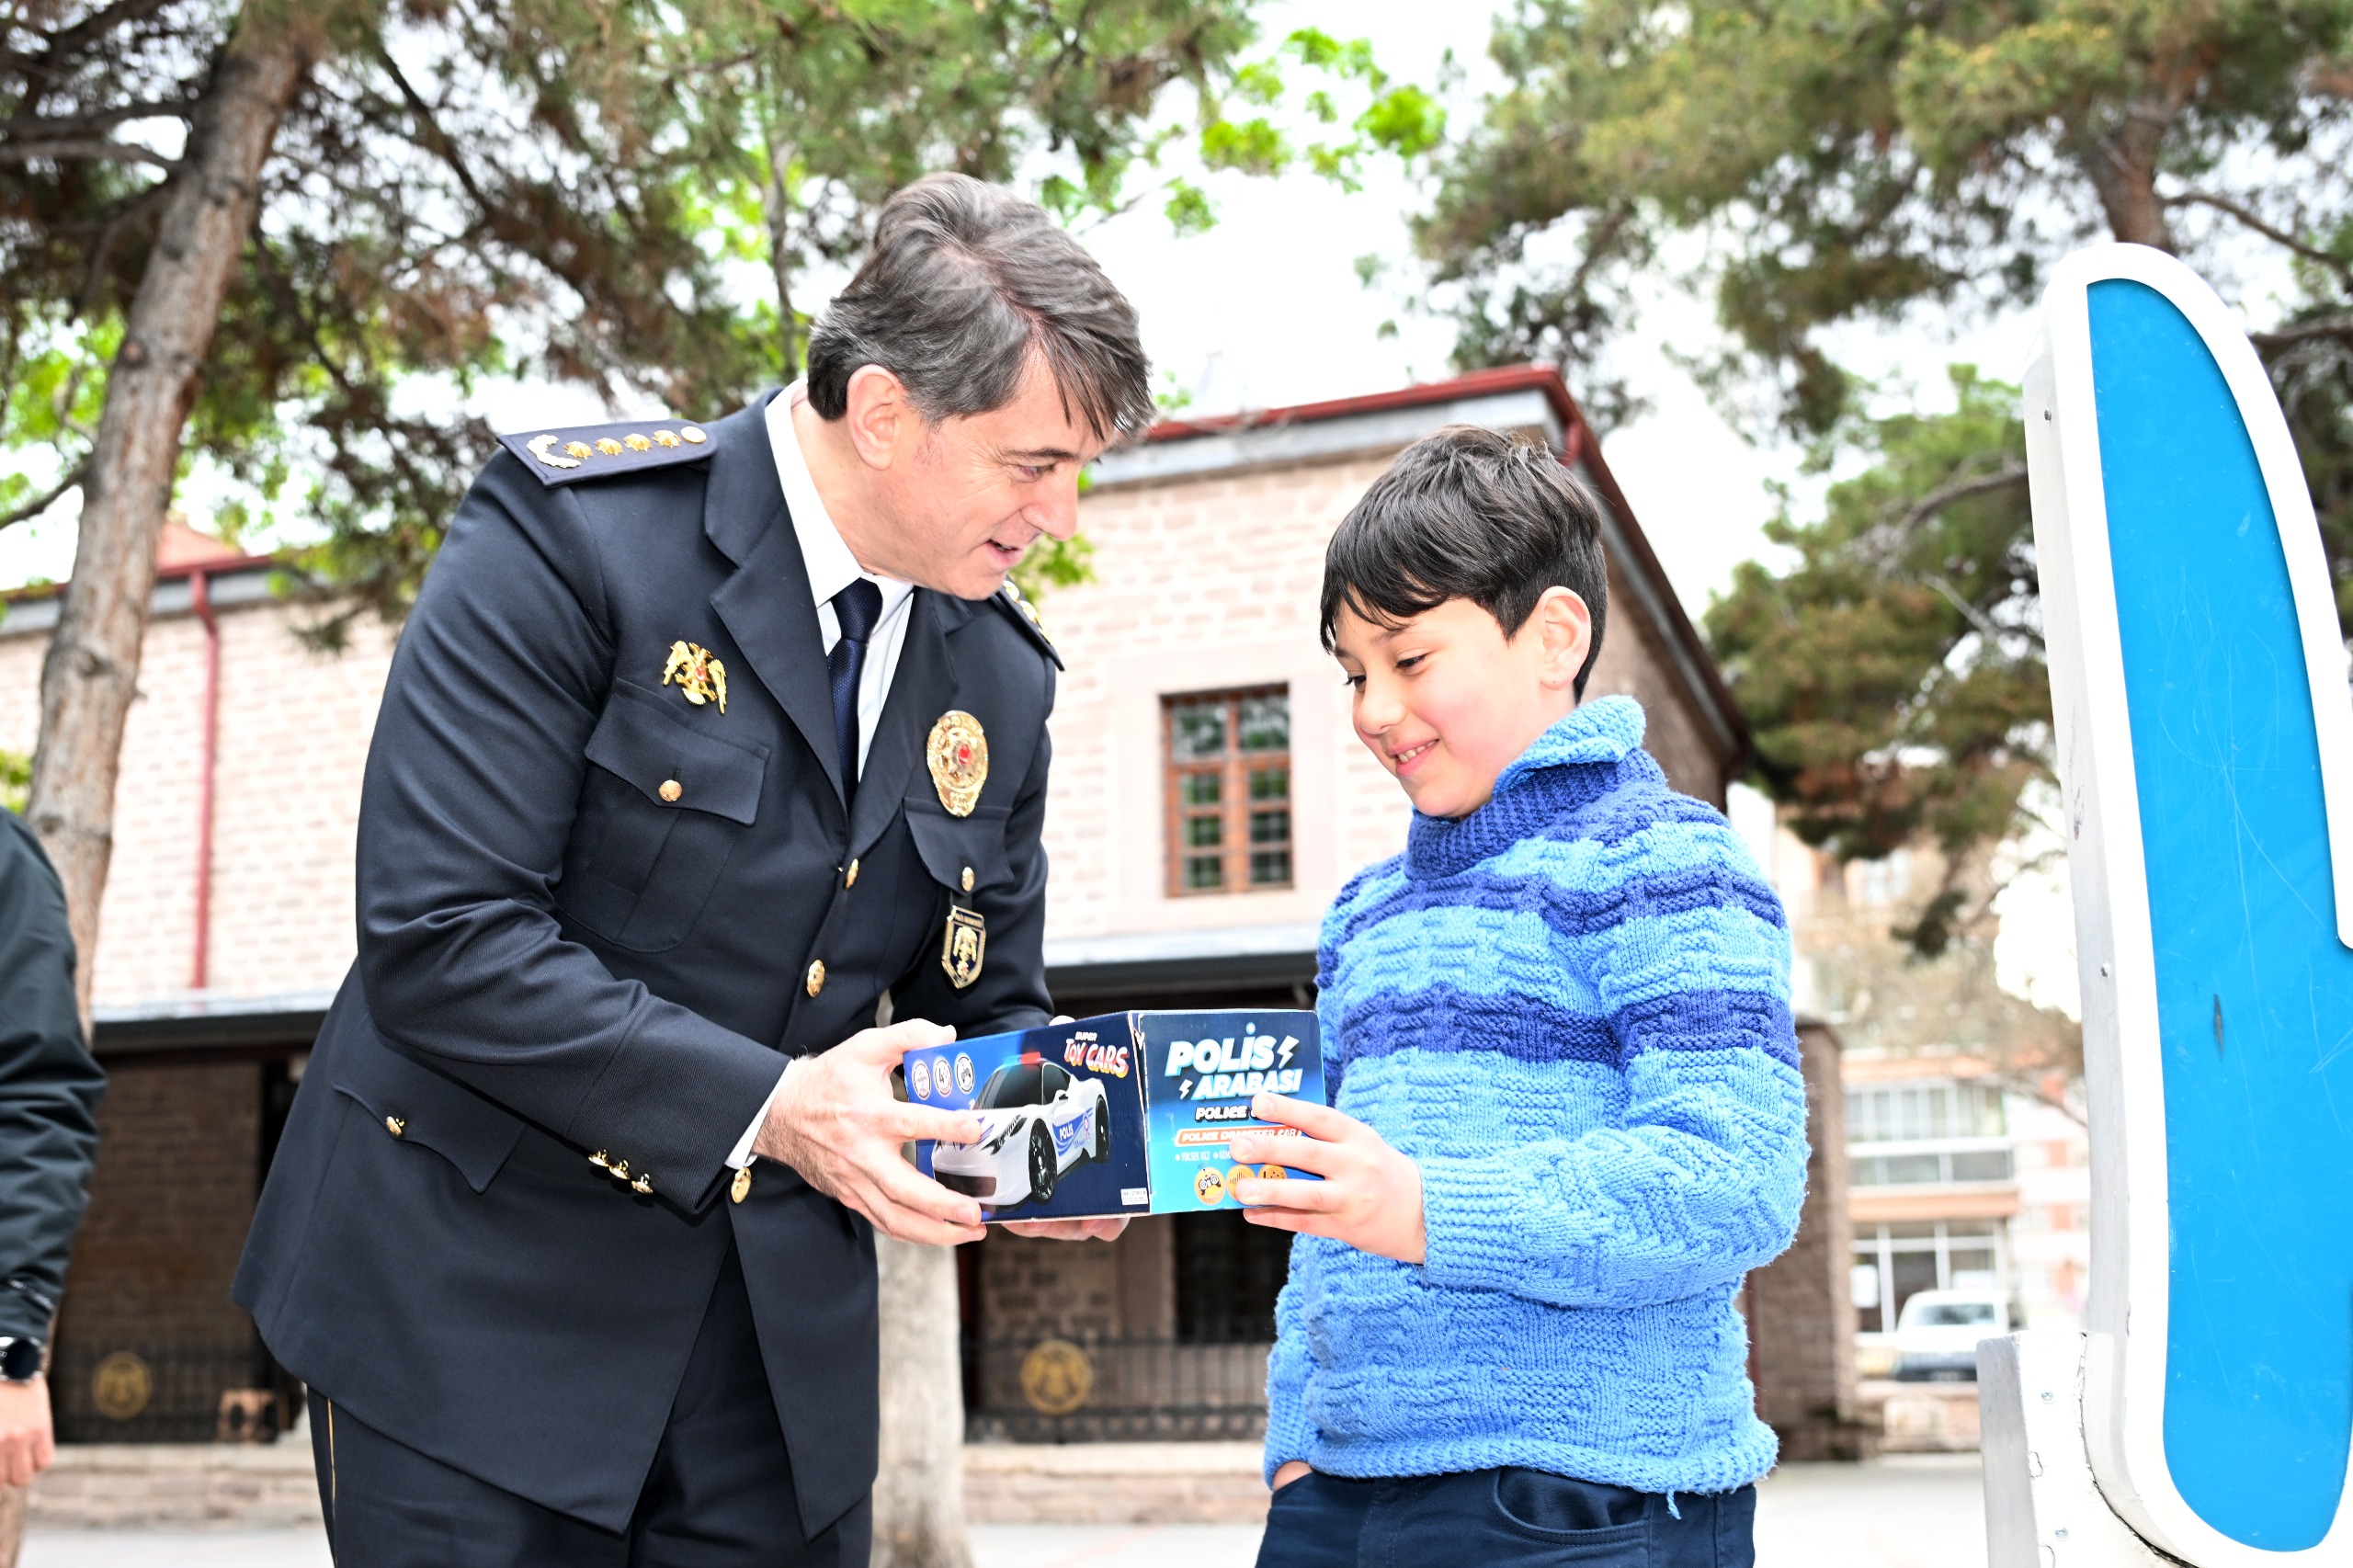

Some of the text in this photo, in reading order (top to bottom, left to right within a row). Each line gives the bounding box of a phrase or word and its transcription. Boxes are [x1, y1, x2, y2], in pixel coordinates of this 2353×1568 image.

[1064, 1039, 1130, 1078] TOY CARS
[1191, 1068, 1303, 1100] ARABASI
[1196, 1106, 1248, 1120] POLICE
[1182, 1131, 1219, 1142] POLICE
